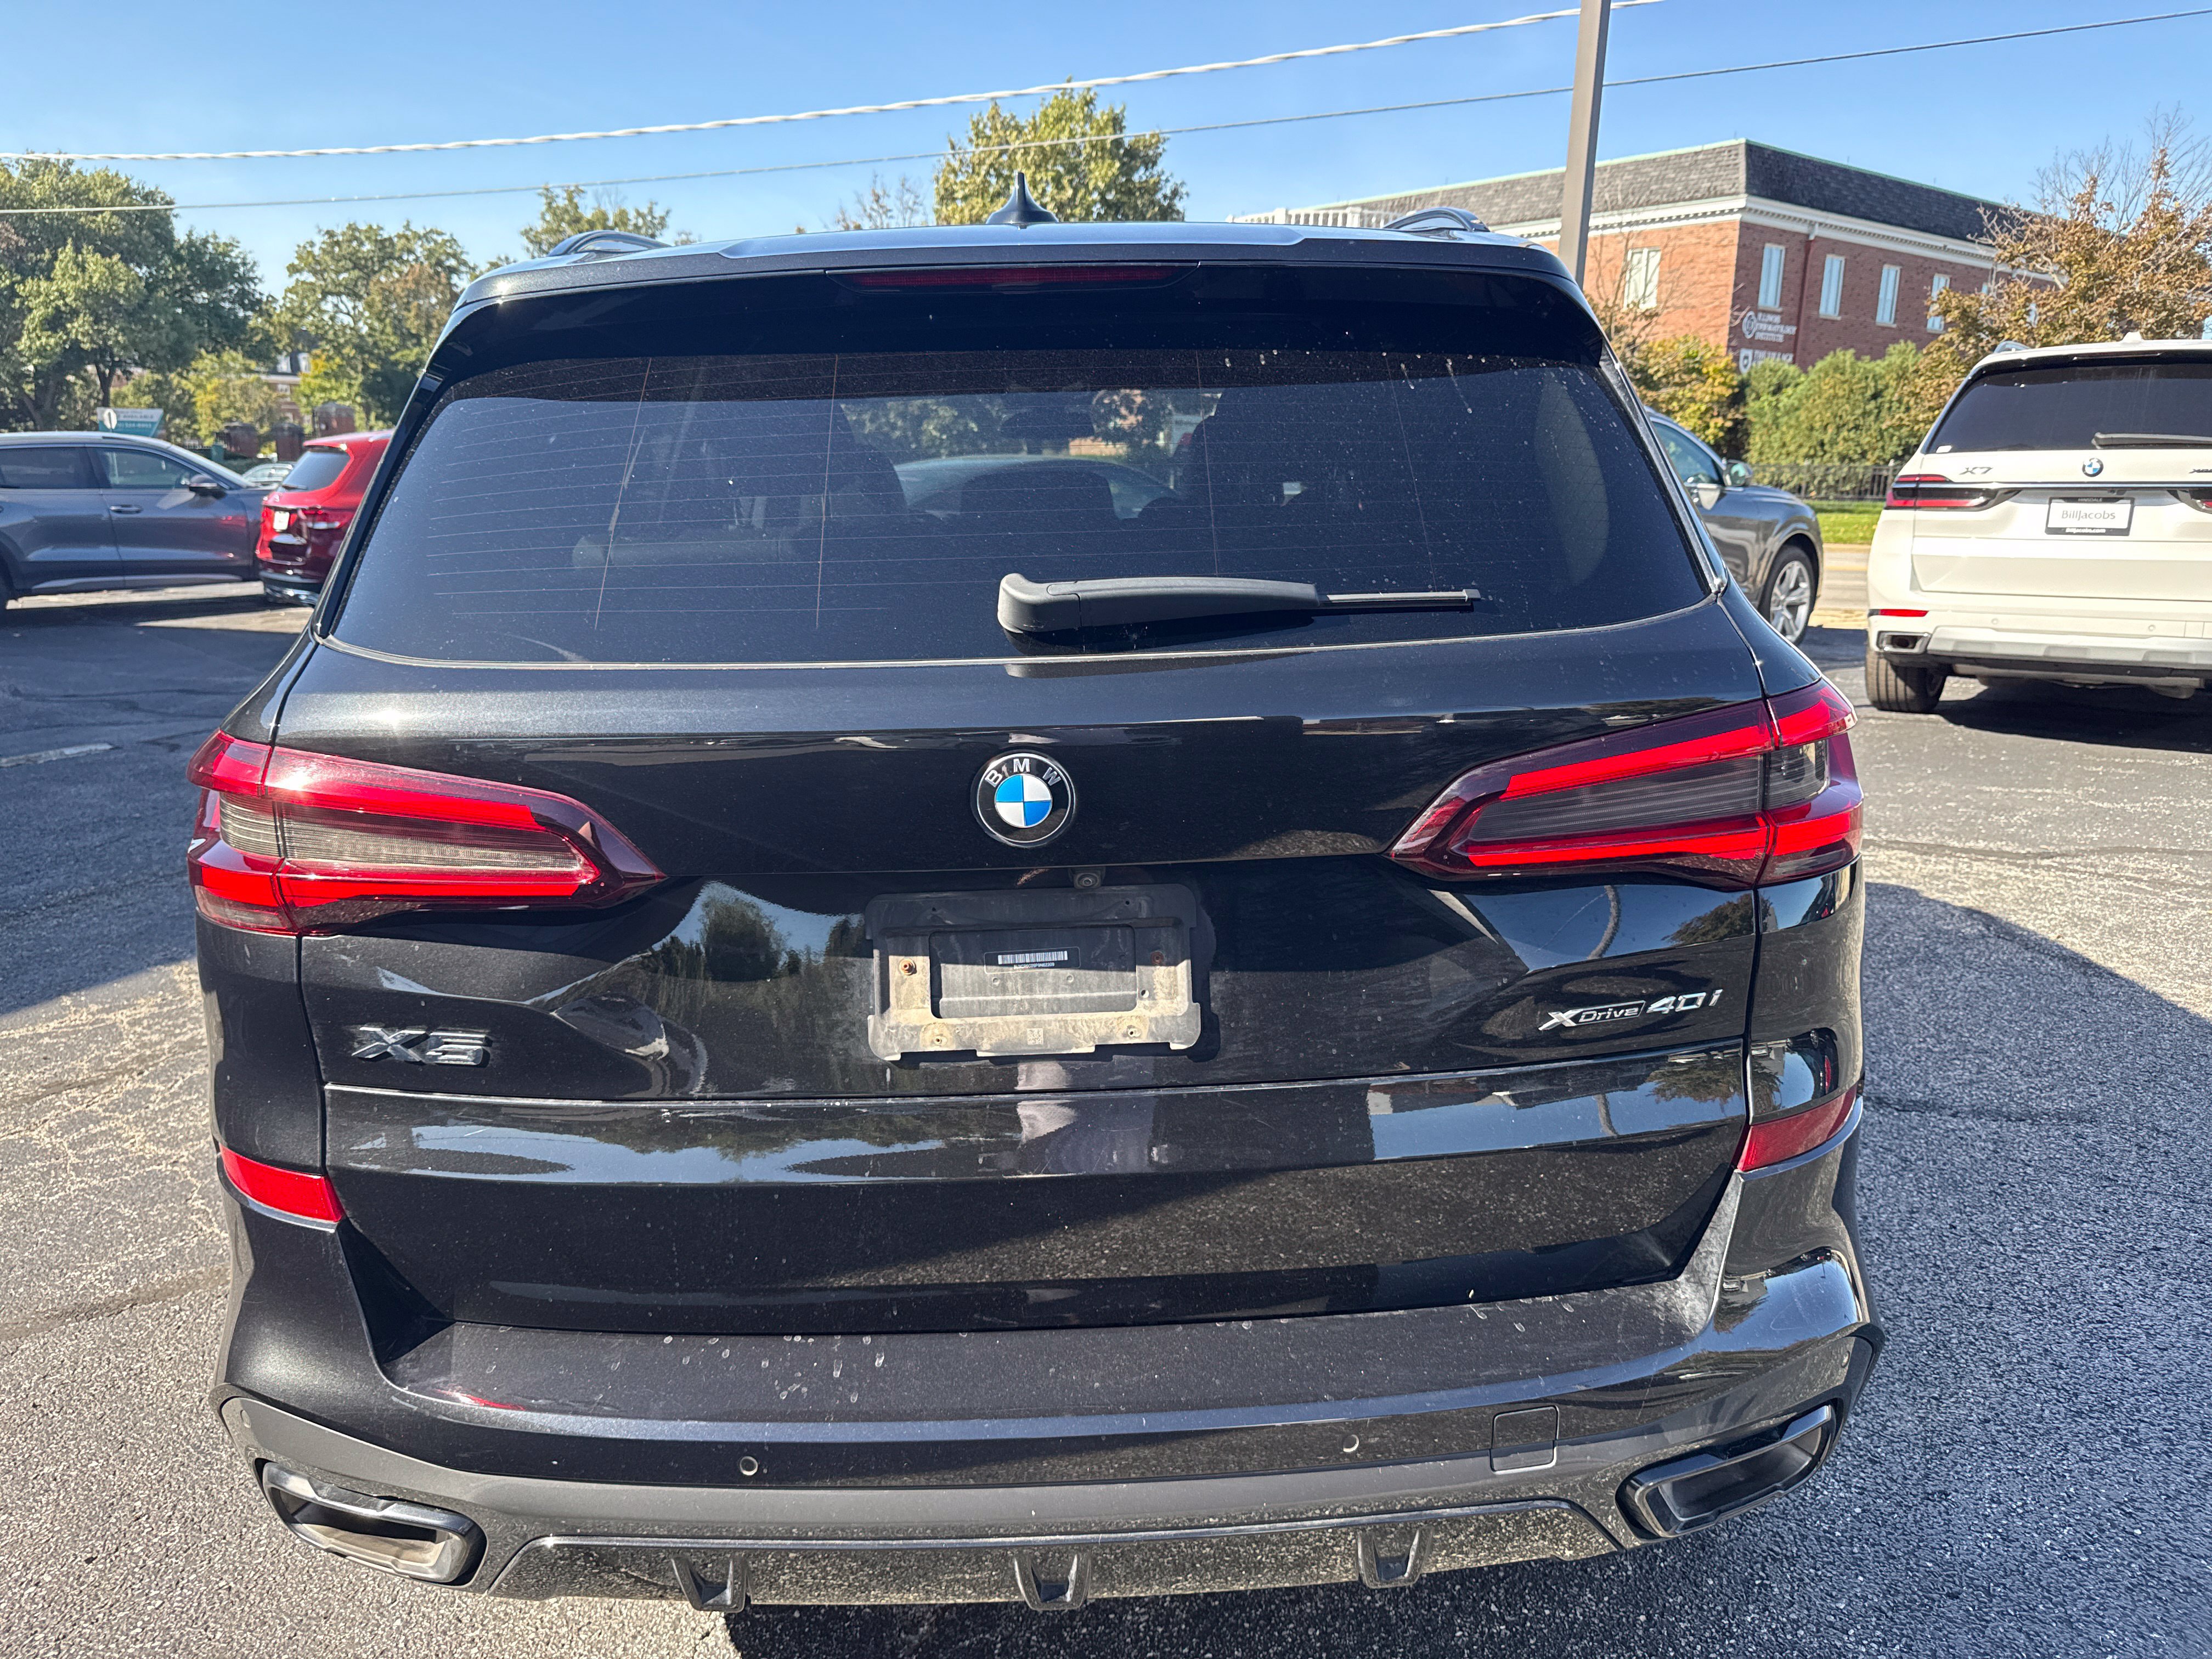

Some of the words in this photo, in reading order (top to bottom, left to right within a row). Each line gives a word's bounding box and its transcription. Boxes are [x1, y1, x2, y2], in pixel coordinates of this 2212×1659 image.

[1959, 466, 1993, 475] X7
[2061, 510, 2116, 521] BillJacobs
[984, 758, 1062, 788] BMW
[1646, 989, 1723, 1015] 40i
[351, 1026, 485, 1066] X5
